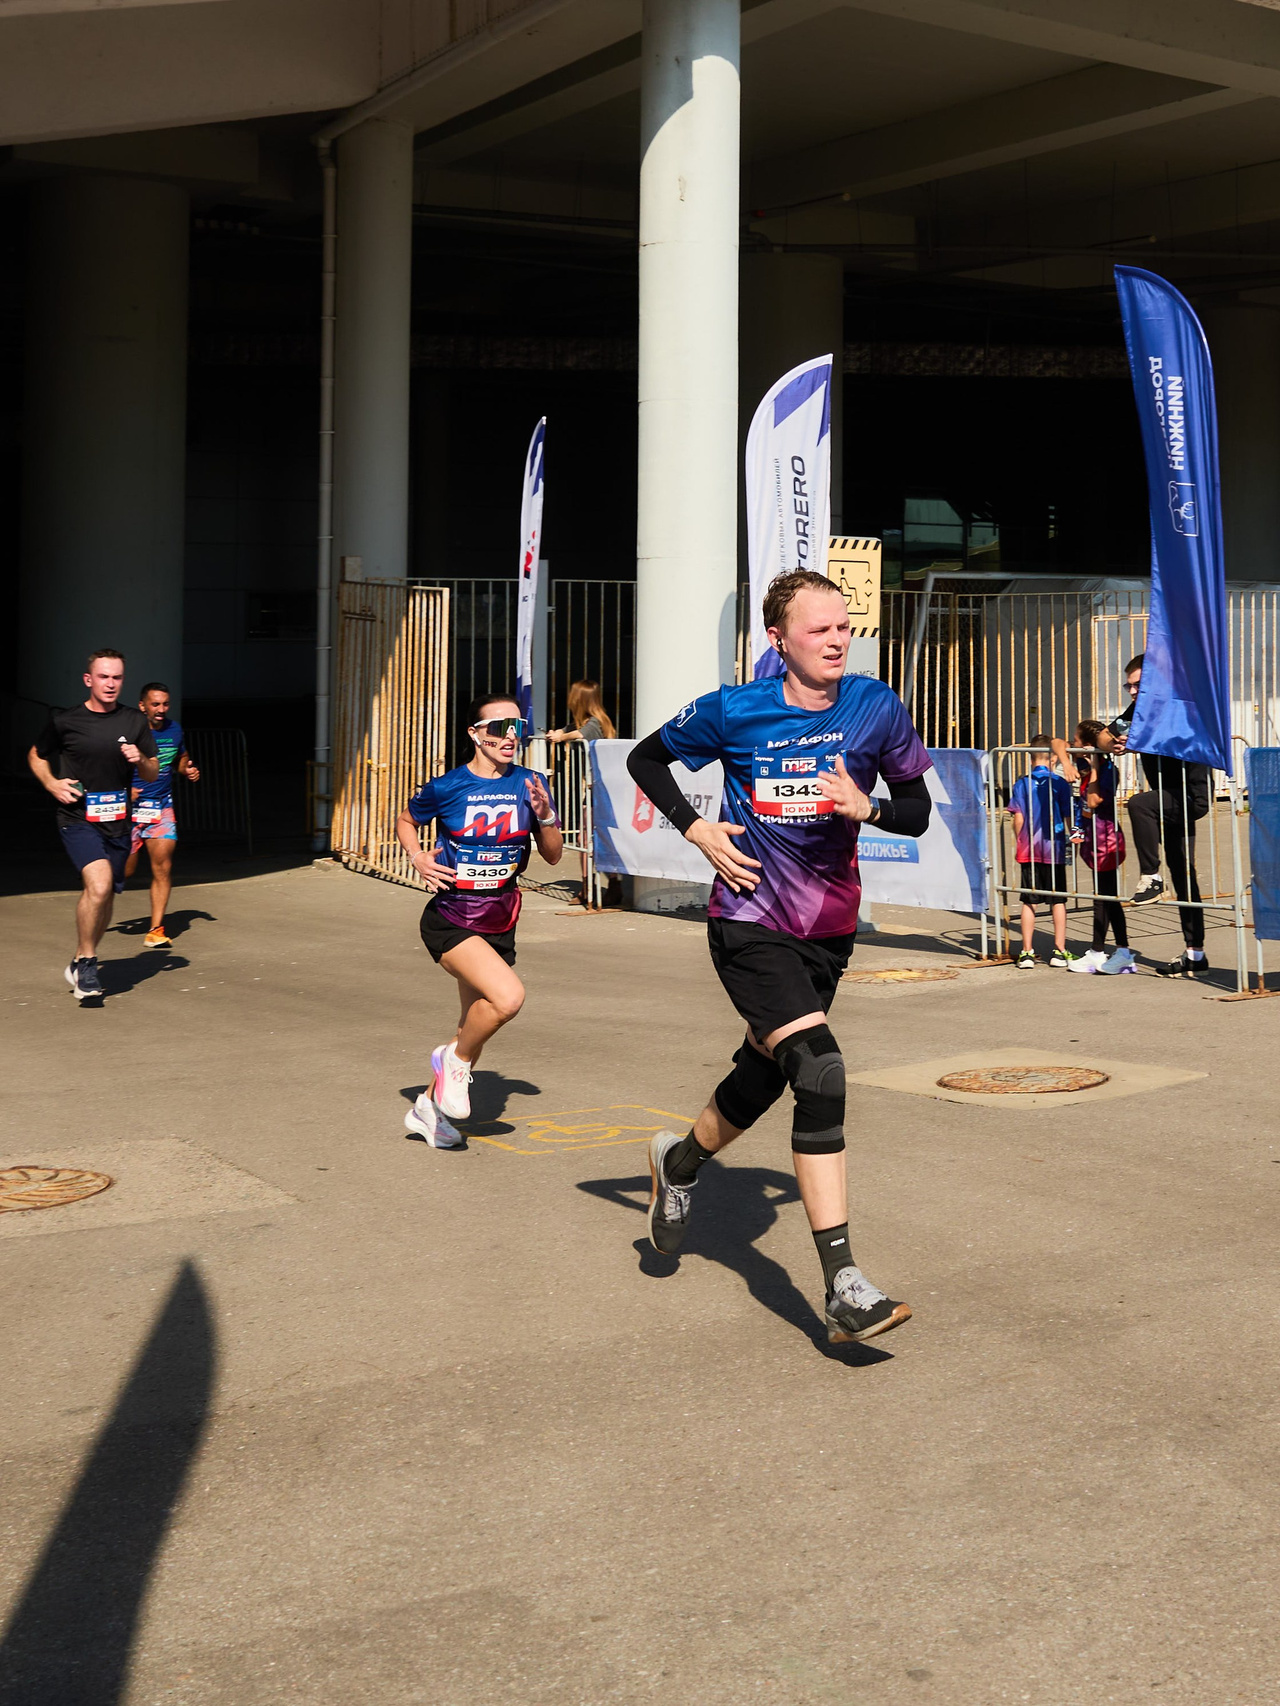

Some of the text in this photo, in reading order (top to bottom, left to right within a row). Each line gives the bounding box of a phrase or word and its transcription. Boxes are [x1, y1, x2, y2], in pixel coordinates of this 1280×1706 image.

[772, 784, 823, 797] 1343
[467, 793, 518, 802] МАРАФОН
[784, 806, 796, 814] 10
[857, 841, 910, 859] ВОЛЖЬЕ
[466, 868, 508, 878] 3430
